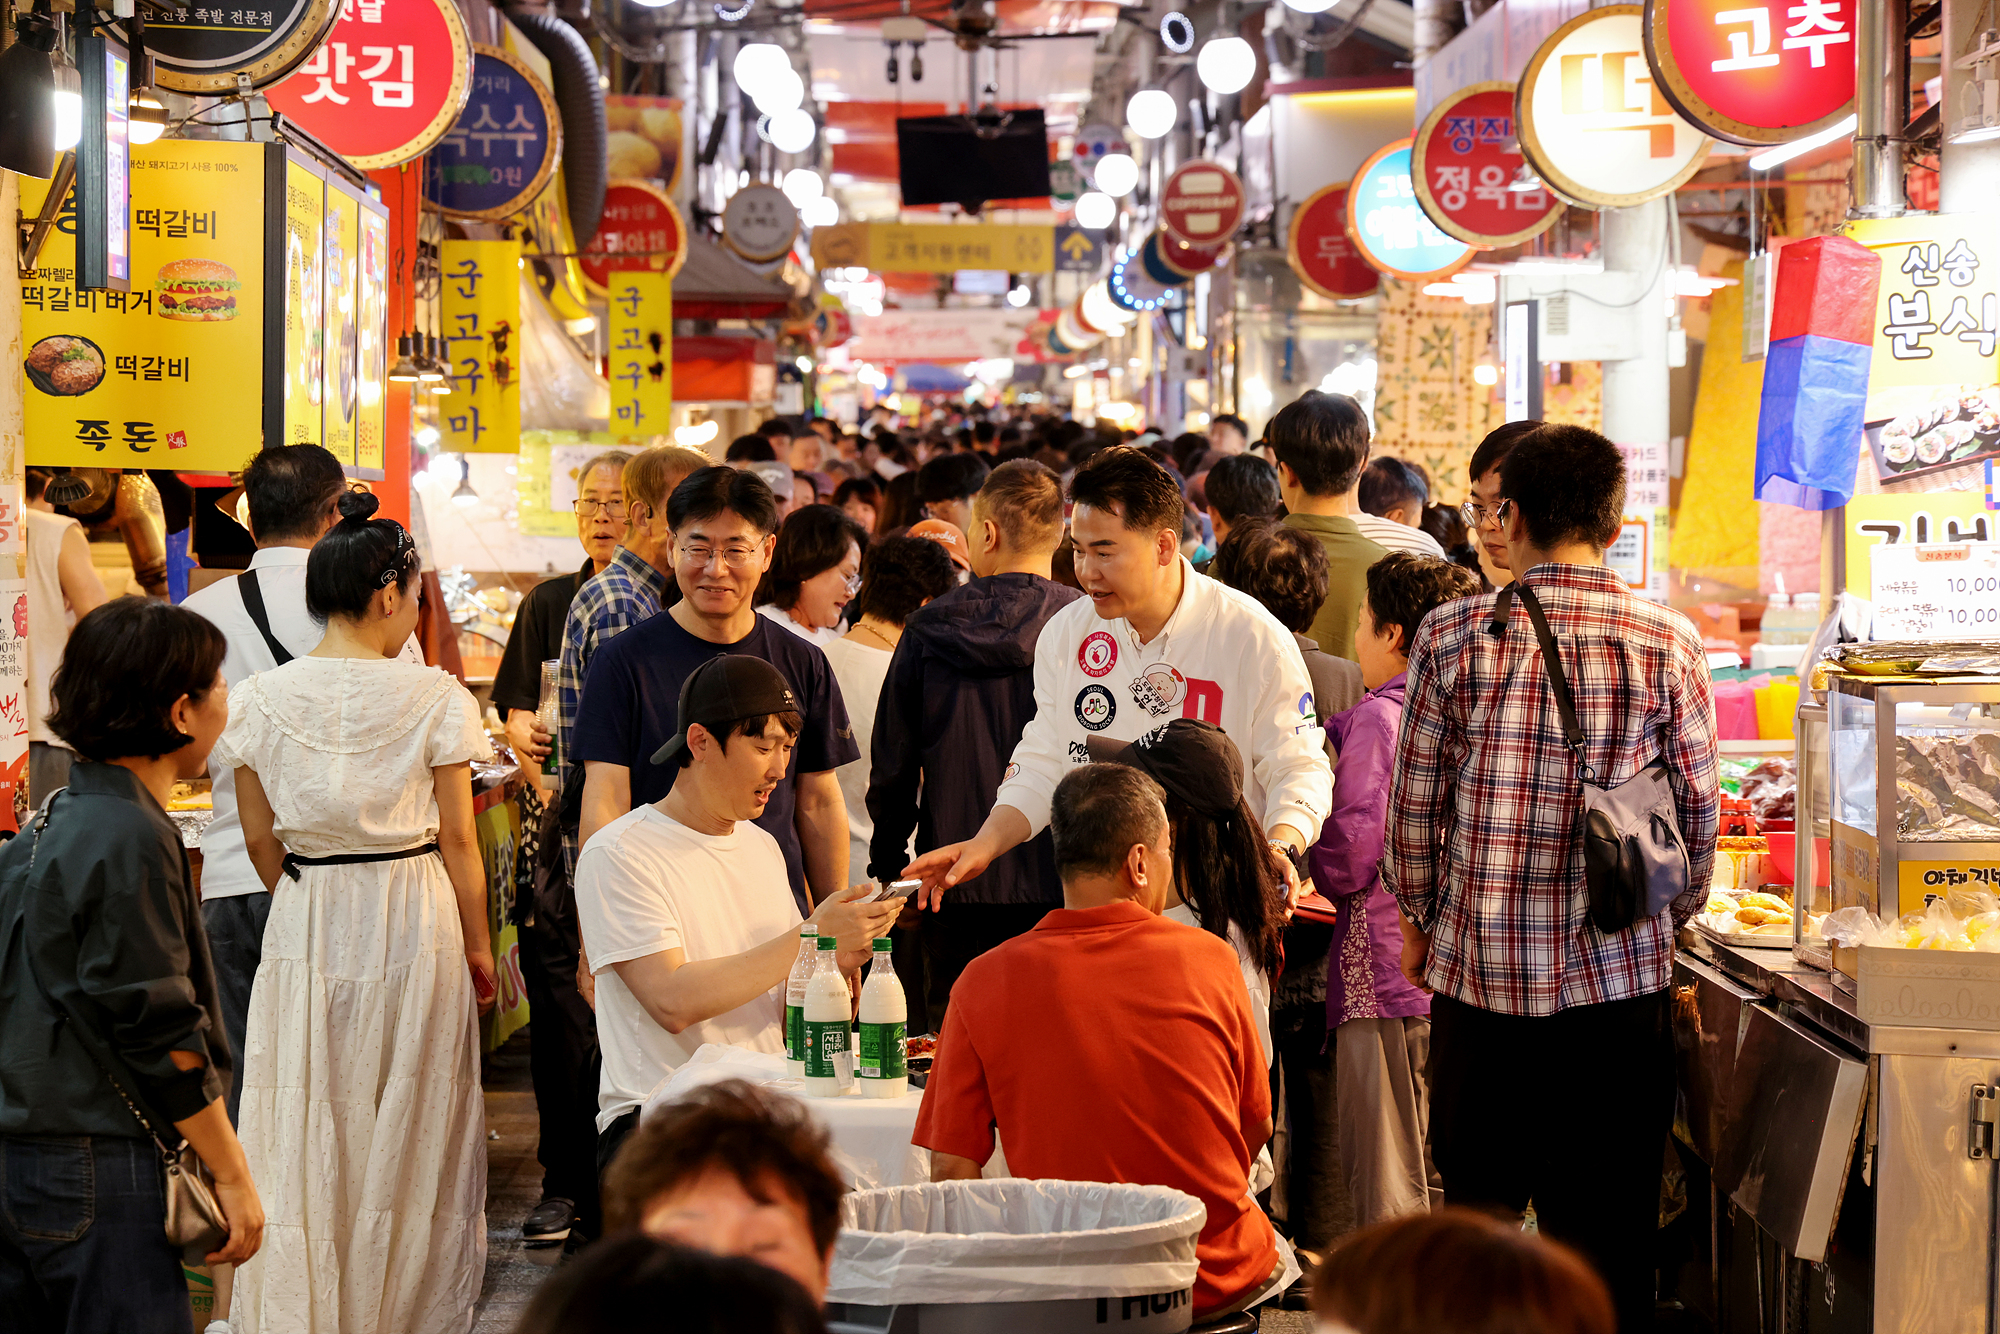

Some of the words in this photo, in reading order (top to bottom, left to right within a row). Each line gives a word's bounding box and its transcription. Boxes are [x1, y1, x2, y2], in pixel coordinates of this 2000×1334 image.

[194, 8, 225, 24] 족발
[230, 10, 272, 26] 전문점
[1711, 0, 1851, 73] 고추
[299, 42, 414, 108] 맛김
[472, 76, 510, 96] 거리
[148, 160, 190, 171] 돼지고기
[191, 161, 212, 172] 사용
[215, 163, 239, 172] 100%
[136, 208, 217, 240] 떡갈비
[1901, 238, 1980, 288] 신송
[21, 286, 97, 313] 떡갈비
[105, 289, 152, 315] 버거
[1882, 290, 1998, 360] 분식
[446, 259, 487, 444] 군고구마
[616, 286, 645, 428] 군고구마
[115, 355, 189, 382] 떡갈비
[1947, 577, 2000, 595] 10,00
[1948, 608, 2000, 626] 10,00
[1086, 685, 1105, 694] SEOUL
[1077, 714, 1098, 730] DOBONG
[1098, 714, 1114, 729] SOCKS
[825, 1033, 842, 1043] 서울
